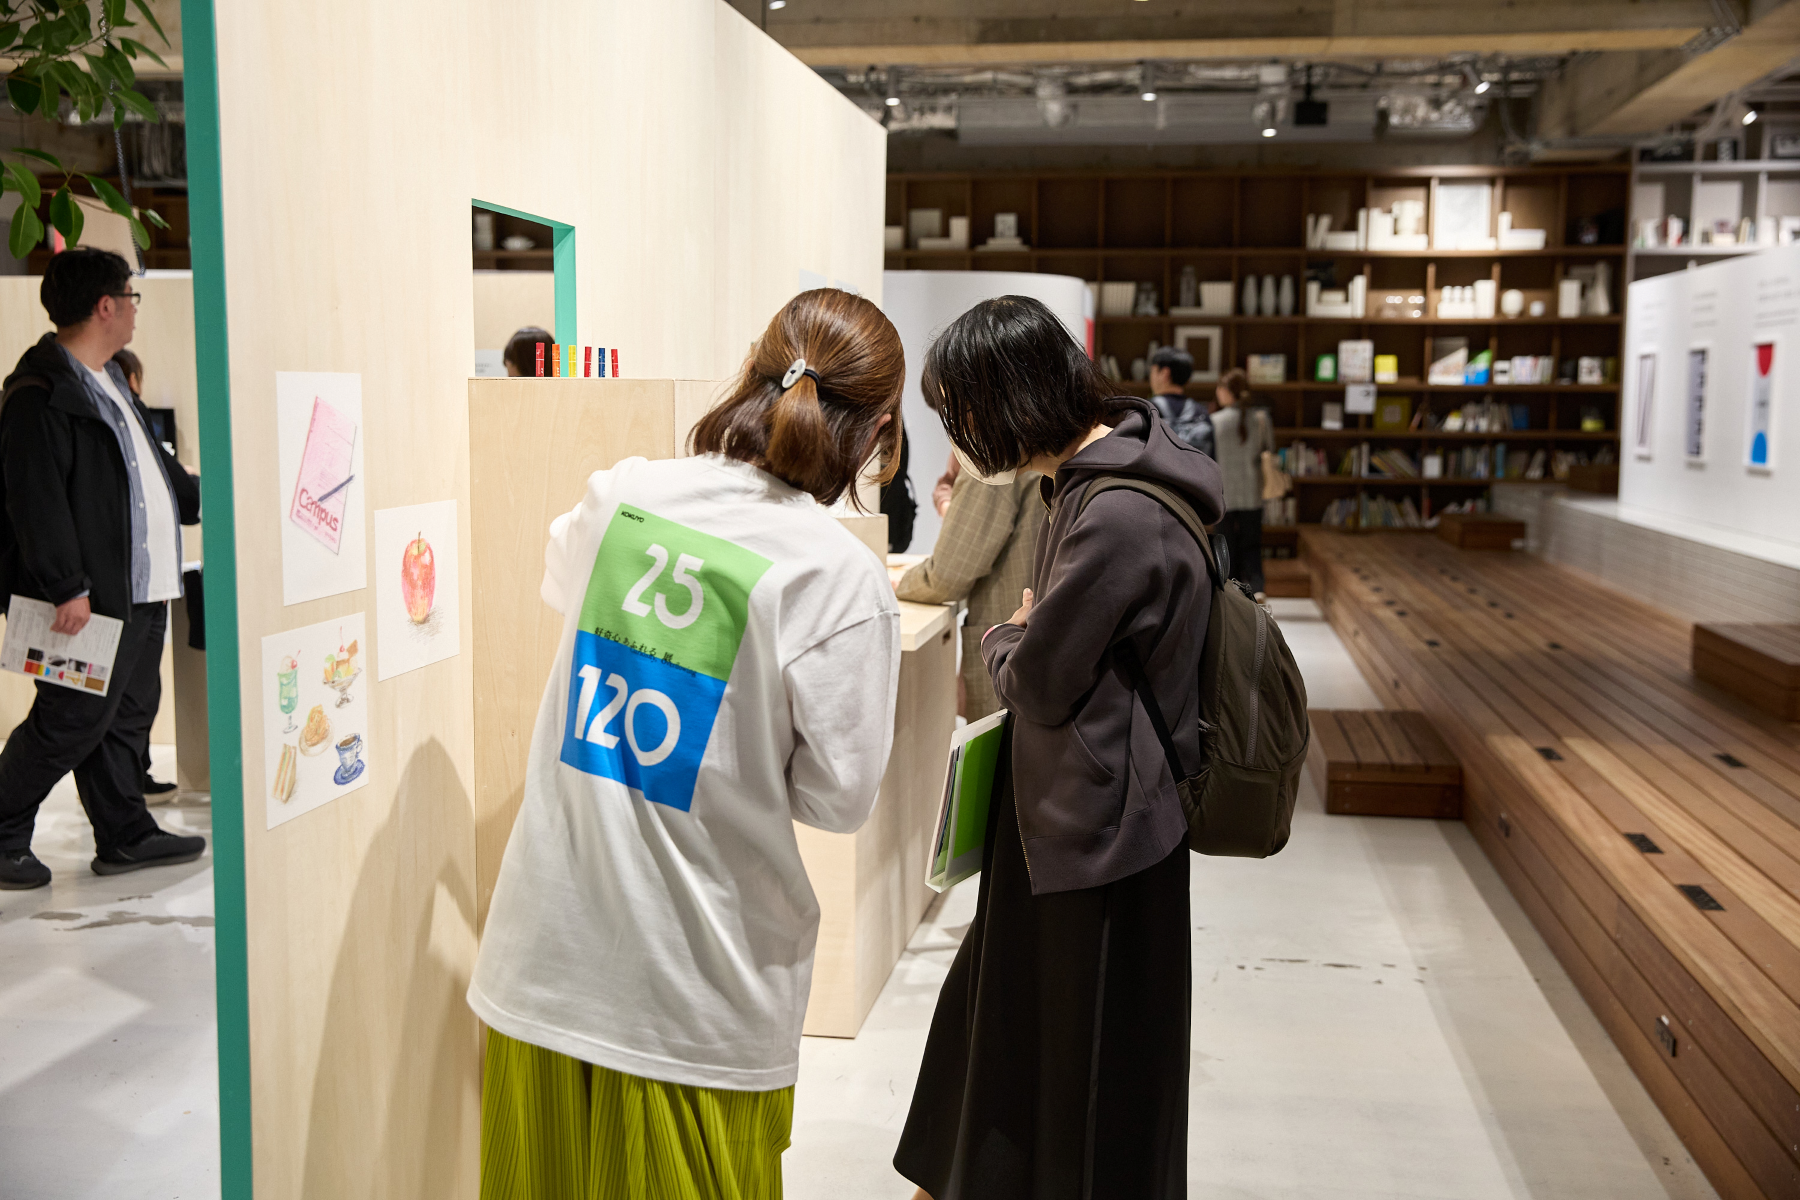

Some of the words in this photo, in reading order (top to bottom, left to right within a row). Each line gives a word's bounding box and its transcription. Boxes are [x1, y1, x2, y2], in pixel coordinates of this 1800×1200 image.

[299, 488, 339, 532] Campus
[621, 511, 645, 523] KOKUYO
[621, 543, 705, 629] 25
[574, 664, 681, 767] 120
